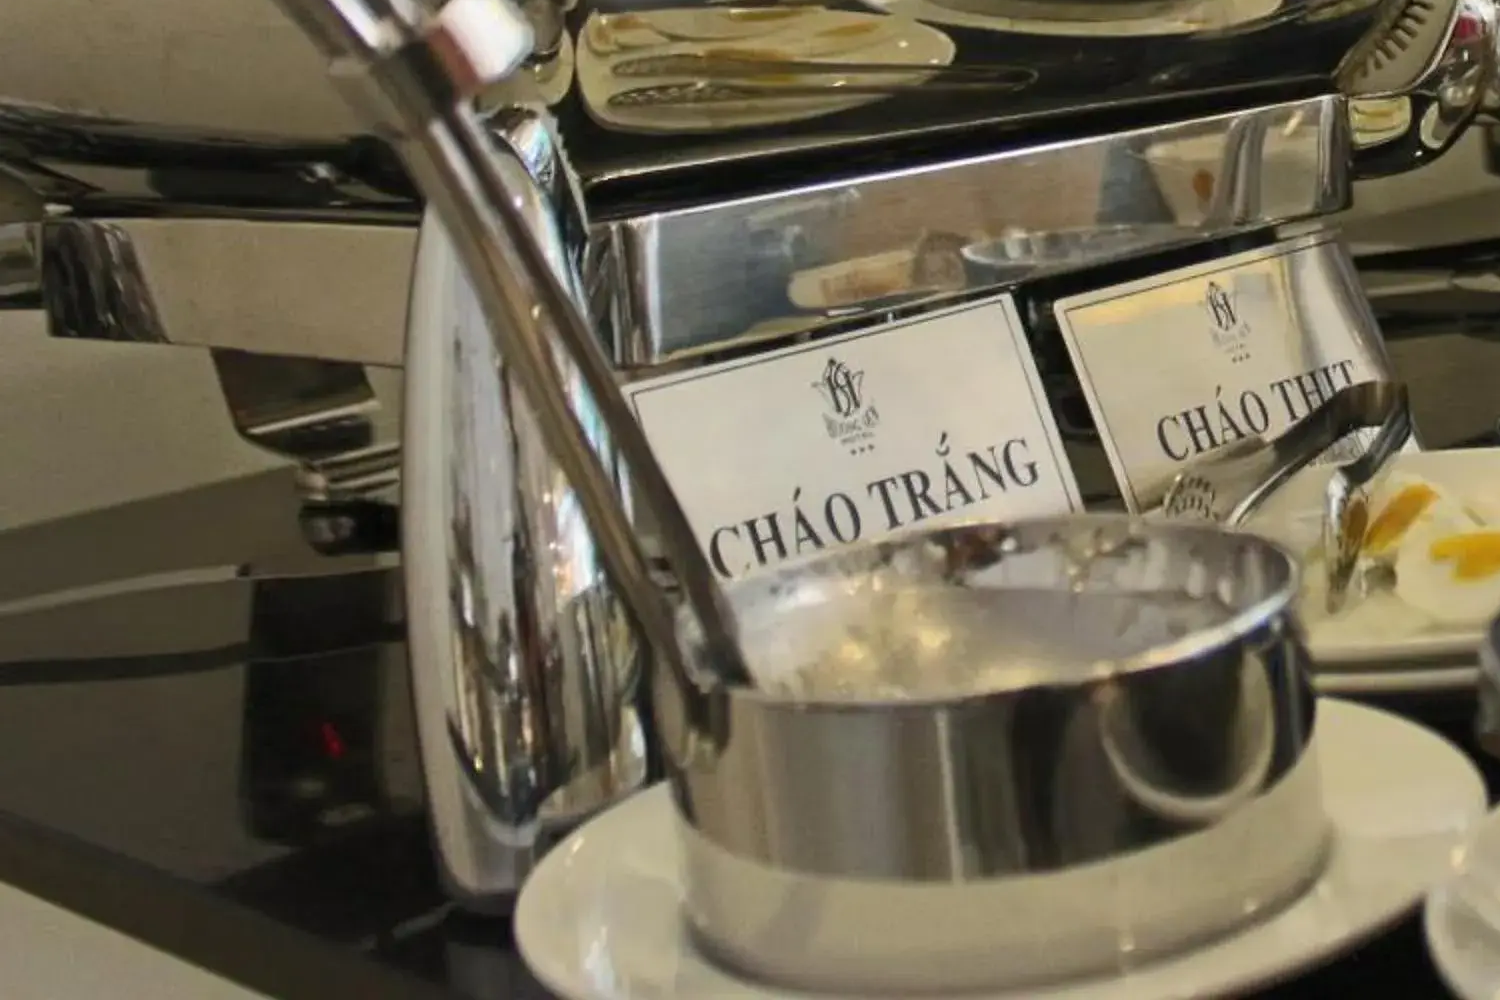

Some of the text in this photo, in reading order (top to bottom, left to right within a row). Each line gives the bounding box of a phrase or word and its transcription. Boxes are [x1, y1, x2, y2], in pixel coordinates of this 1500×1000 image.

[1156, 384, 1270, 461] CHÁO
[709, 431, 1041, 578] CHÁO TRẮNG
